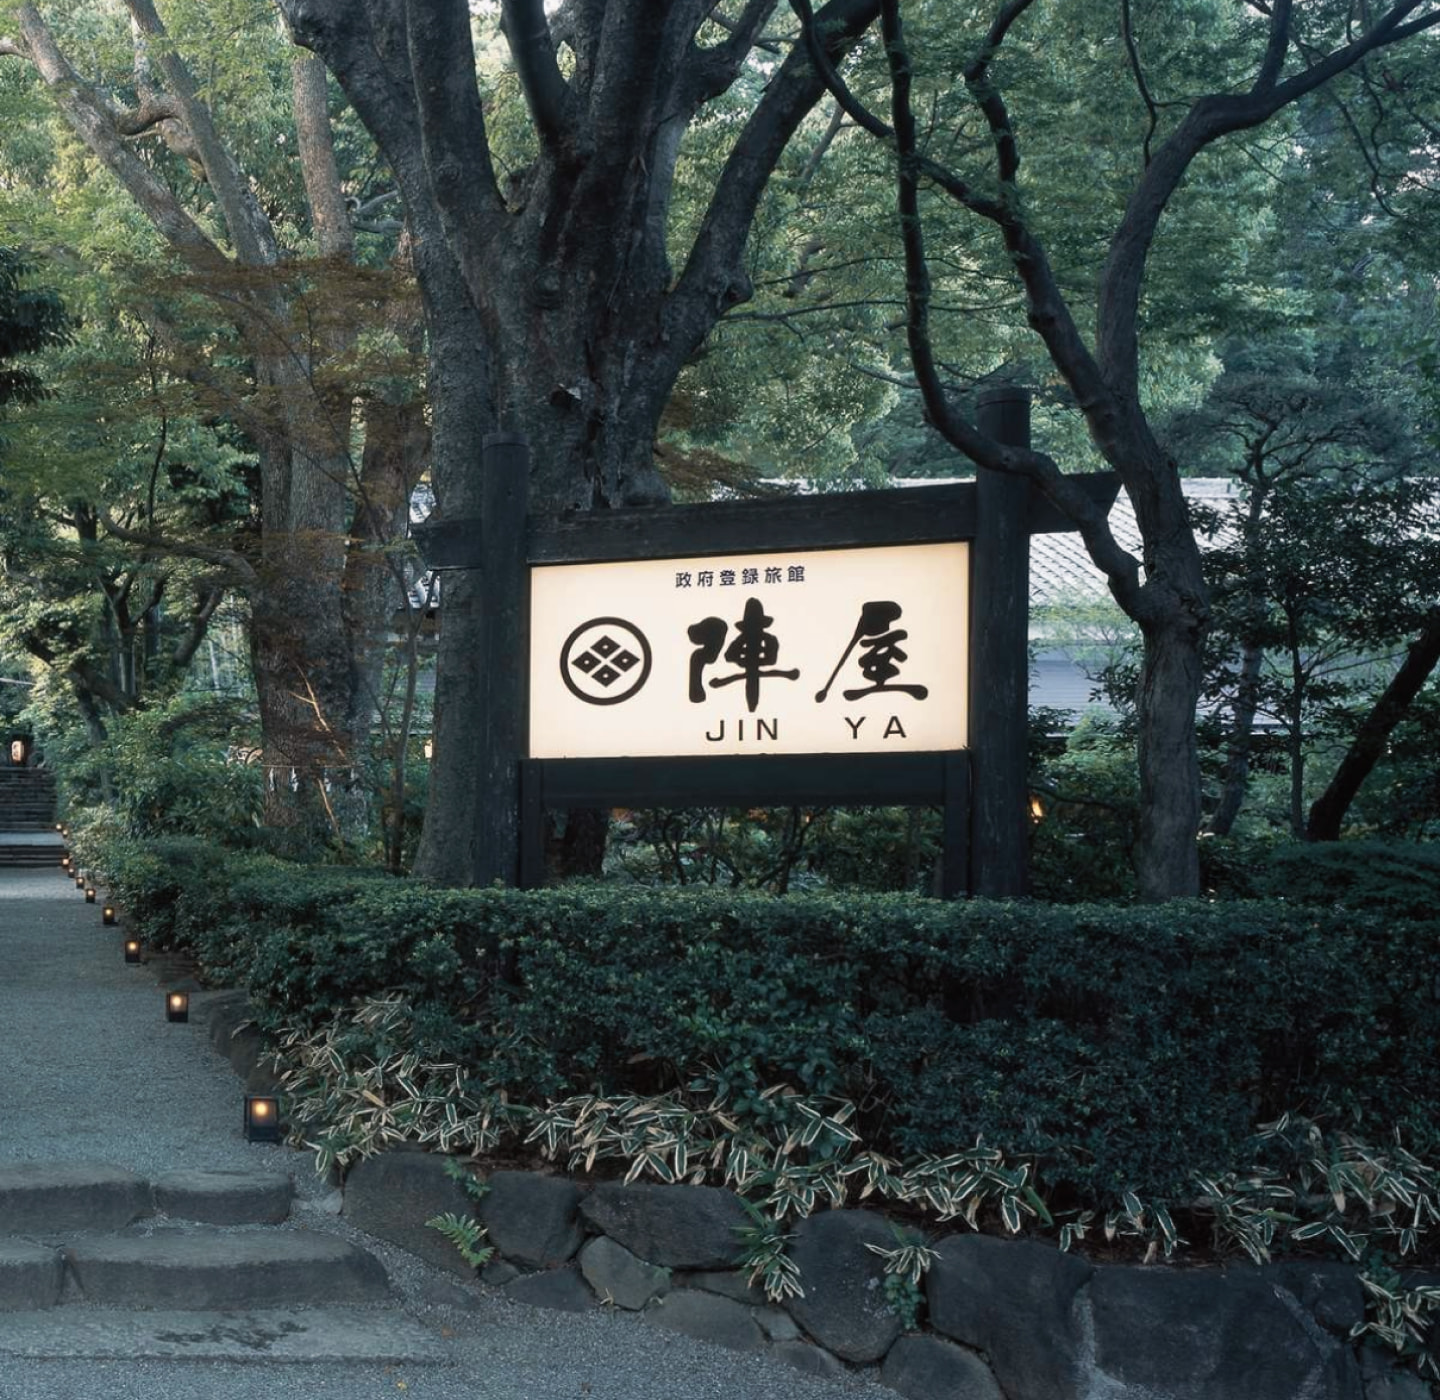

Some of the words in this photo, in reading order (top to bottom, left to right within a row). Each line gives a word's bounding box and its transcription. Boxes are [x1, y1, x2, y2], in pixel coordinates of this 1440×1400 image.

[675, 565, 806, 588] 政府登録旅館
[687, 597, 929, 713] 陣屋
[705, 718, 779, 742] JIN
[844, 715, 907, 740] YA
